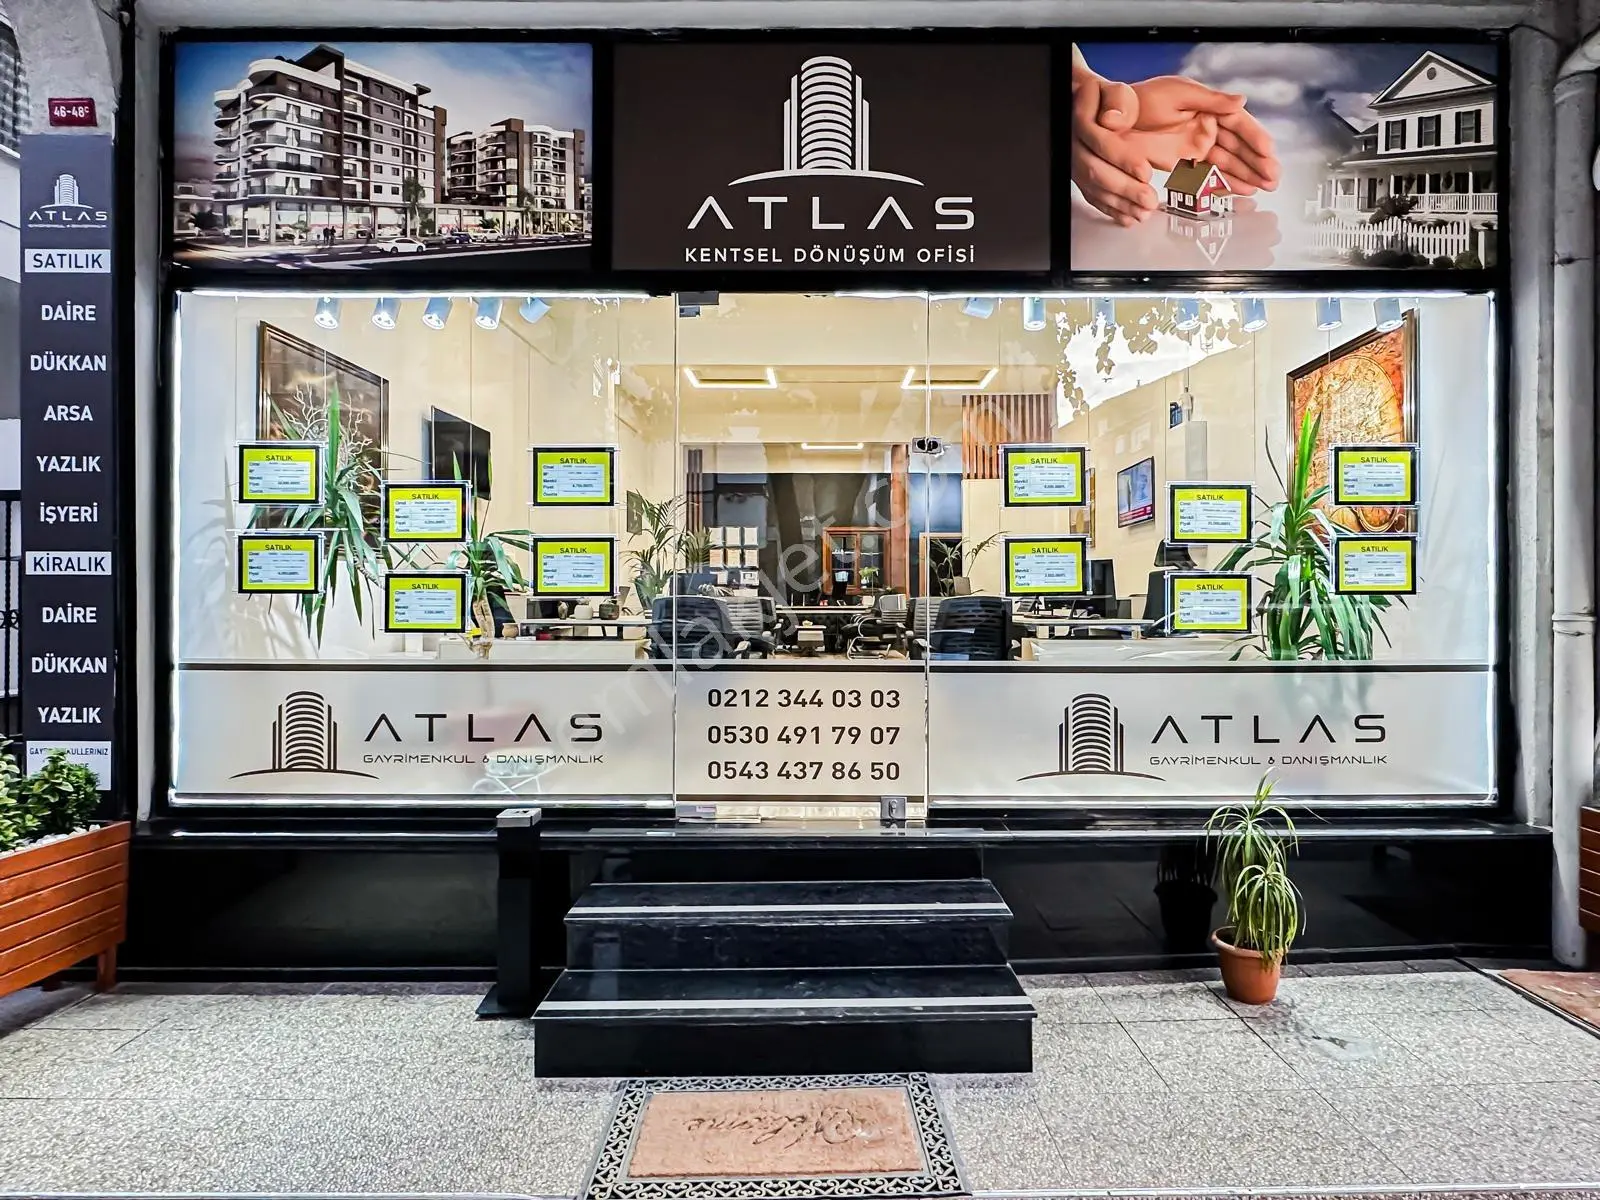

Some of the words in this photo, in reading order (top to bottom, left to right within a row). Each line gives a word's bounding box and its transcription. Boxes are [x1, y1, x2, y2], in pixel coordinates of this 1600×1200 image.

[29, 211, 107, 221] ATLAS
[687, 195, 975, 230] ATLAS
[33, 253, 103, 268] SATILIK
[685, 247, 782, 263] KENTSEL
[794, 245, 904, 265] DÖNÜŞÜM
[917, 245, 975, 263] OFİSİ
[41, 301, 96, 321] DAİRE
[30, 351, 107, 371] DÜKKAN
[44, 405, 93, 421] ARSA
[37, 456, 101, 472] YAZLIK
[40, 502, 98, 524] İŞYERİ
[33, 553, 106, 572] KİRALIK
[42, 603, 97, 623] DAİRE
[31, 653, 107, 673] DÜKKAN
[708, 689, 769, 708] 0212
[777, 689, 823, 708] 344
[832, 690, 862, 708] 03
[870, 690, 900, 708] 03
[38, 707, 102, 724] YAZLIK
[364, 713, 603, 742] ATLAS
[708, 726, 769, 744] 0530
[777, 726, 820, 744] 491
[831, 726, 861, 745] 79
[870, 726, 900, 745] 07
[1151, 714, 1386, 743] ATLAS
[363, 752, 475, 764] GAYRİMENKUL
[482, 755, 490, 764] &
[497, 754, 604, 766] DANIŞMANLIK
[1149, 754, 1261, 765] GAYRİMENKUL
[1267, 756, 1275, 765] &
[1282, 755, 1387, 766] DANIŞMANLIK
[708, 761, 769, 779] 0543
[777, 761, 823, 780] 437
[831, 762, 861, 780] 86
[870, 762, 900, 780] 50
